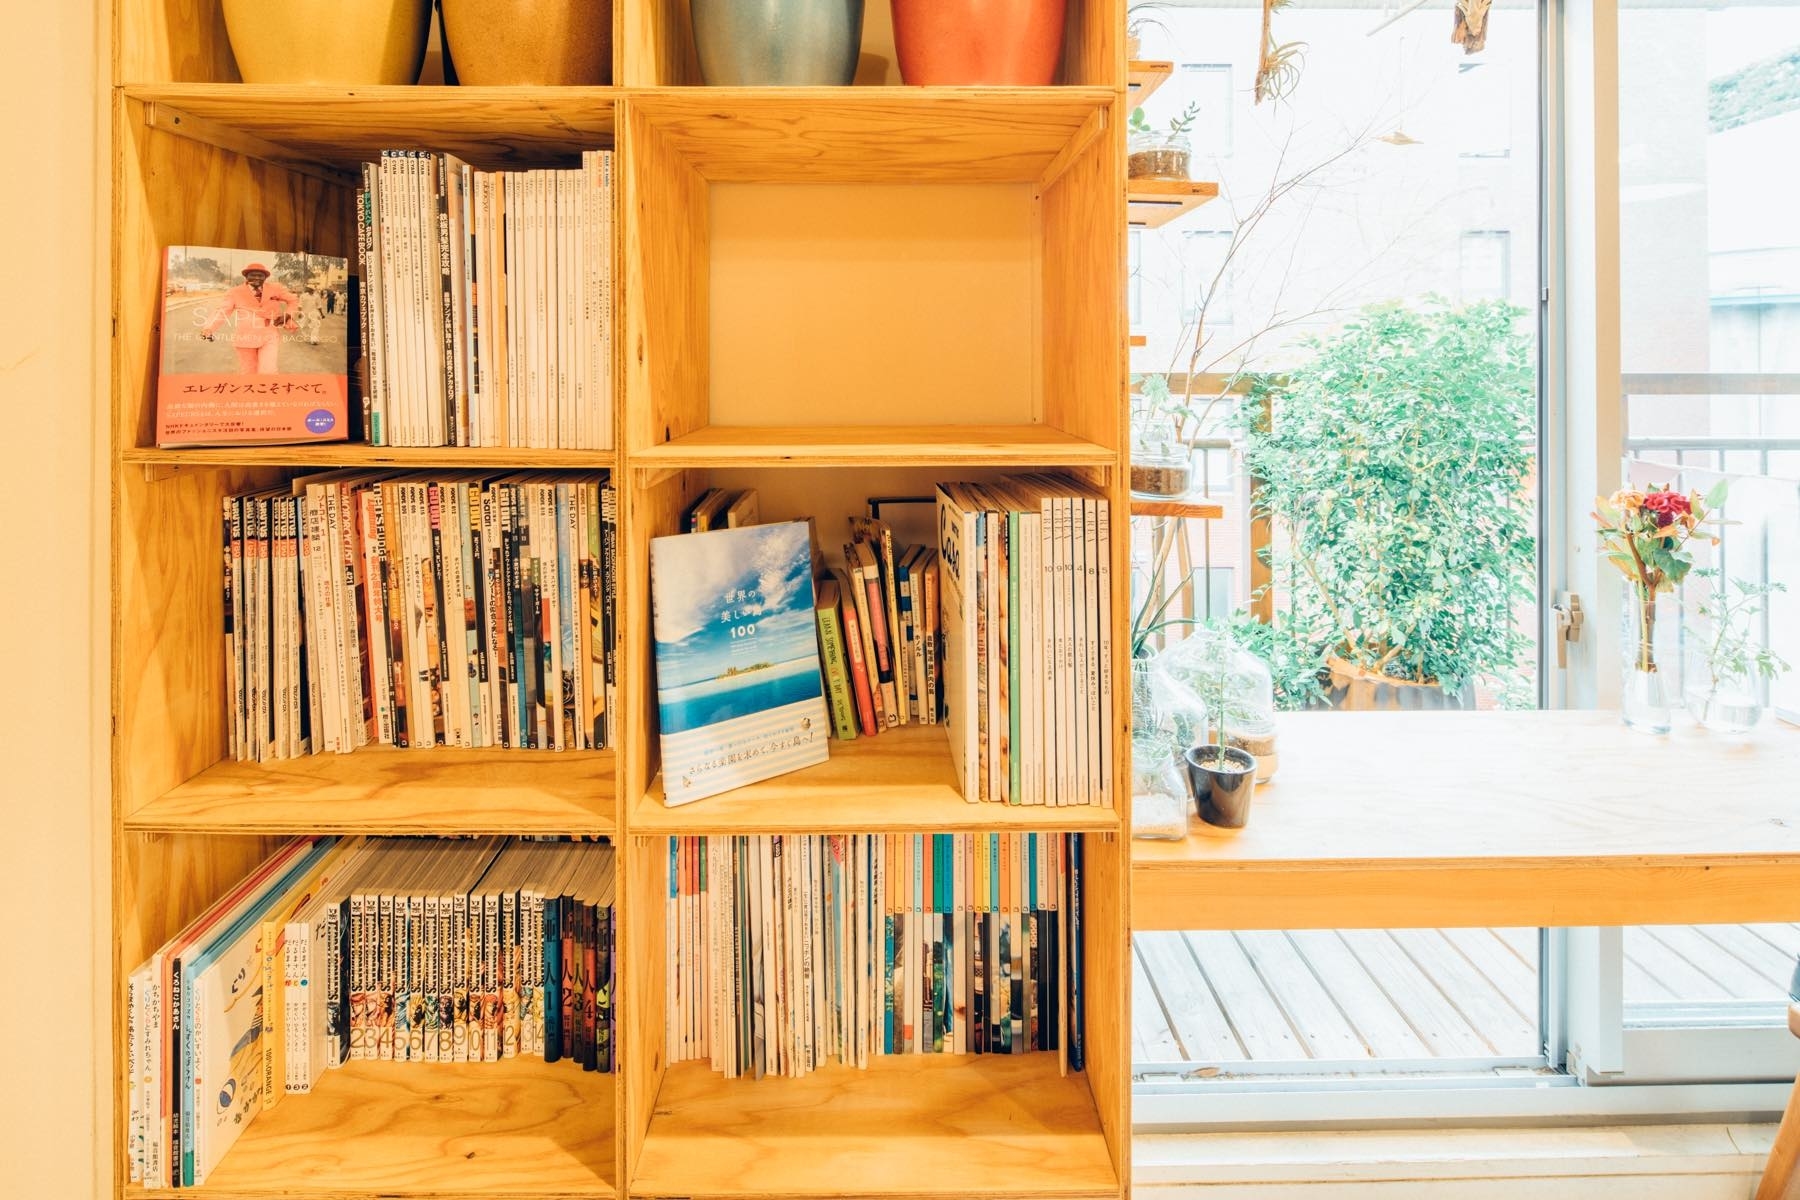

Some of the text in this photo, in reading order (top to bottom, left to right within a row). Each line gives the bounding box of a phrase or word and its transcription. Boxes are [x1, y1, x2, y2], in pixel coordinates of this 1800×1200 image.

[358, 220, 366, 243] CAFE
[174, 333, 192, 341] THE
[183, 382, 328, 395] エレガンスこそすべて。
[232, 501, 240, 538] BRUTUS
[247, 501, 255, 536] BRUTUS
[259, 501, 268, 538] BRUTUS
[288, 500, 296, 536] BRUTUS
[368, 499, 377, 540] Lightning
[1064, 507, 1072, 539] CREA
[1074, 509, 1082, 540] CREA
[1087, 511, 1095, 542] CREA
[1100, 510, 1108, 542] CREA
[377, 525, 387, 562] FUDGE
[940, 503, 960, 580] Casa
[1043, 509, 1052, 573] CREA 10
[1054, 509, 1063, 573] CREA 9
[725, 590, 756, 604] 世界の
[730, 623, 755, 638] 100
[152, 984, 160, 1029] かちかちやま
[547, 992, 552, 1010] 1
[563, 988, 573, 1008] 2
[574, 992, 583, 1012] 3
[585, 999, 594, 1019] 4
[351, 1029, 364, 1050] 2
[365, 1029, 376, 1049] 3
[380, 1029, 392, 1049] 4
[395, 1029, 406, 1050] 5
[410, 1029, 421, 1050] 6
[426, 1029, 437, 1050] 7
[440, 1030, 451, 1051] 8
[454, 1024, 466, 1045] 9
